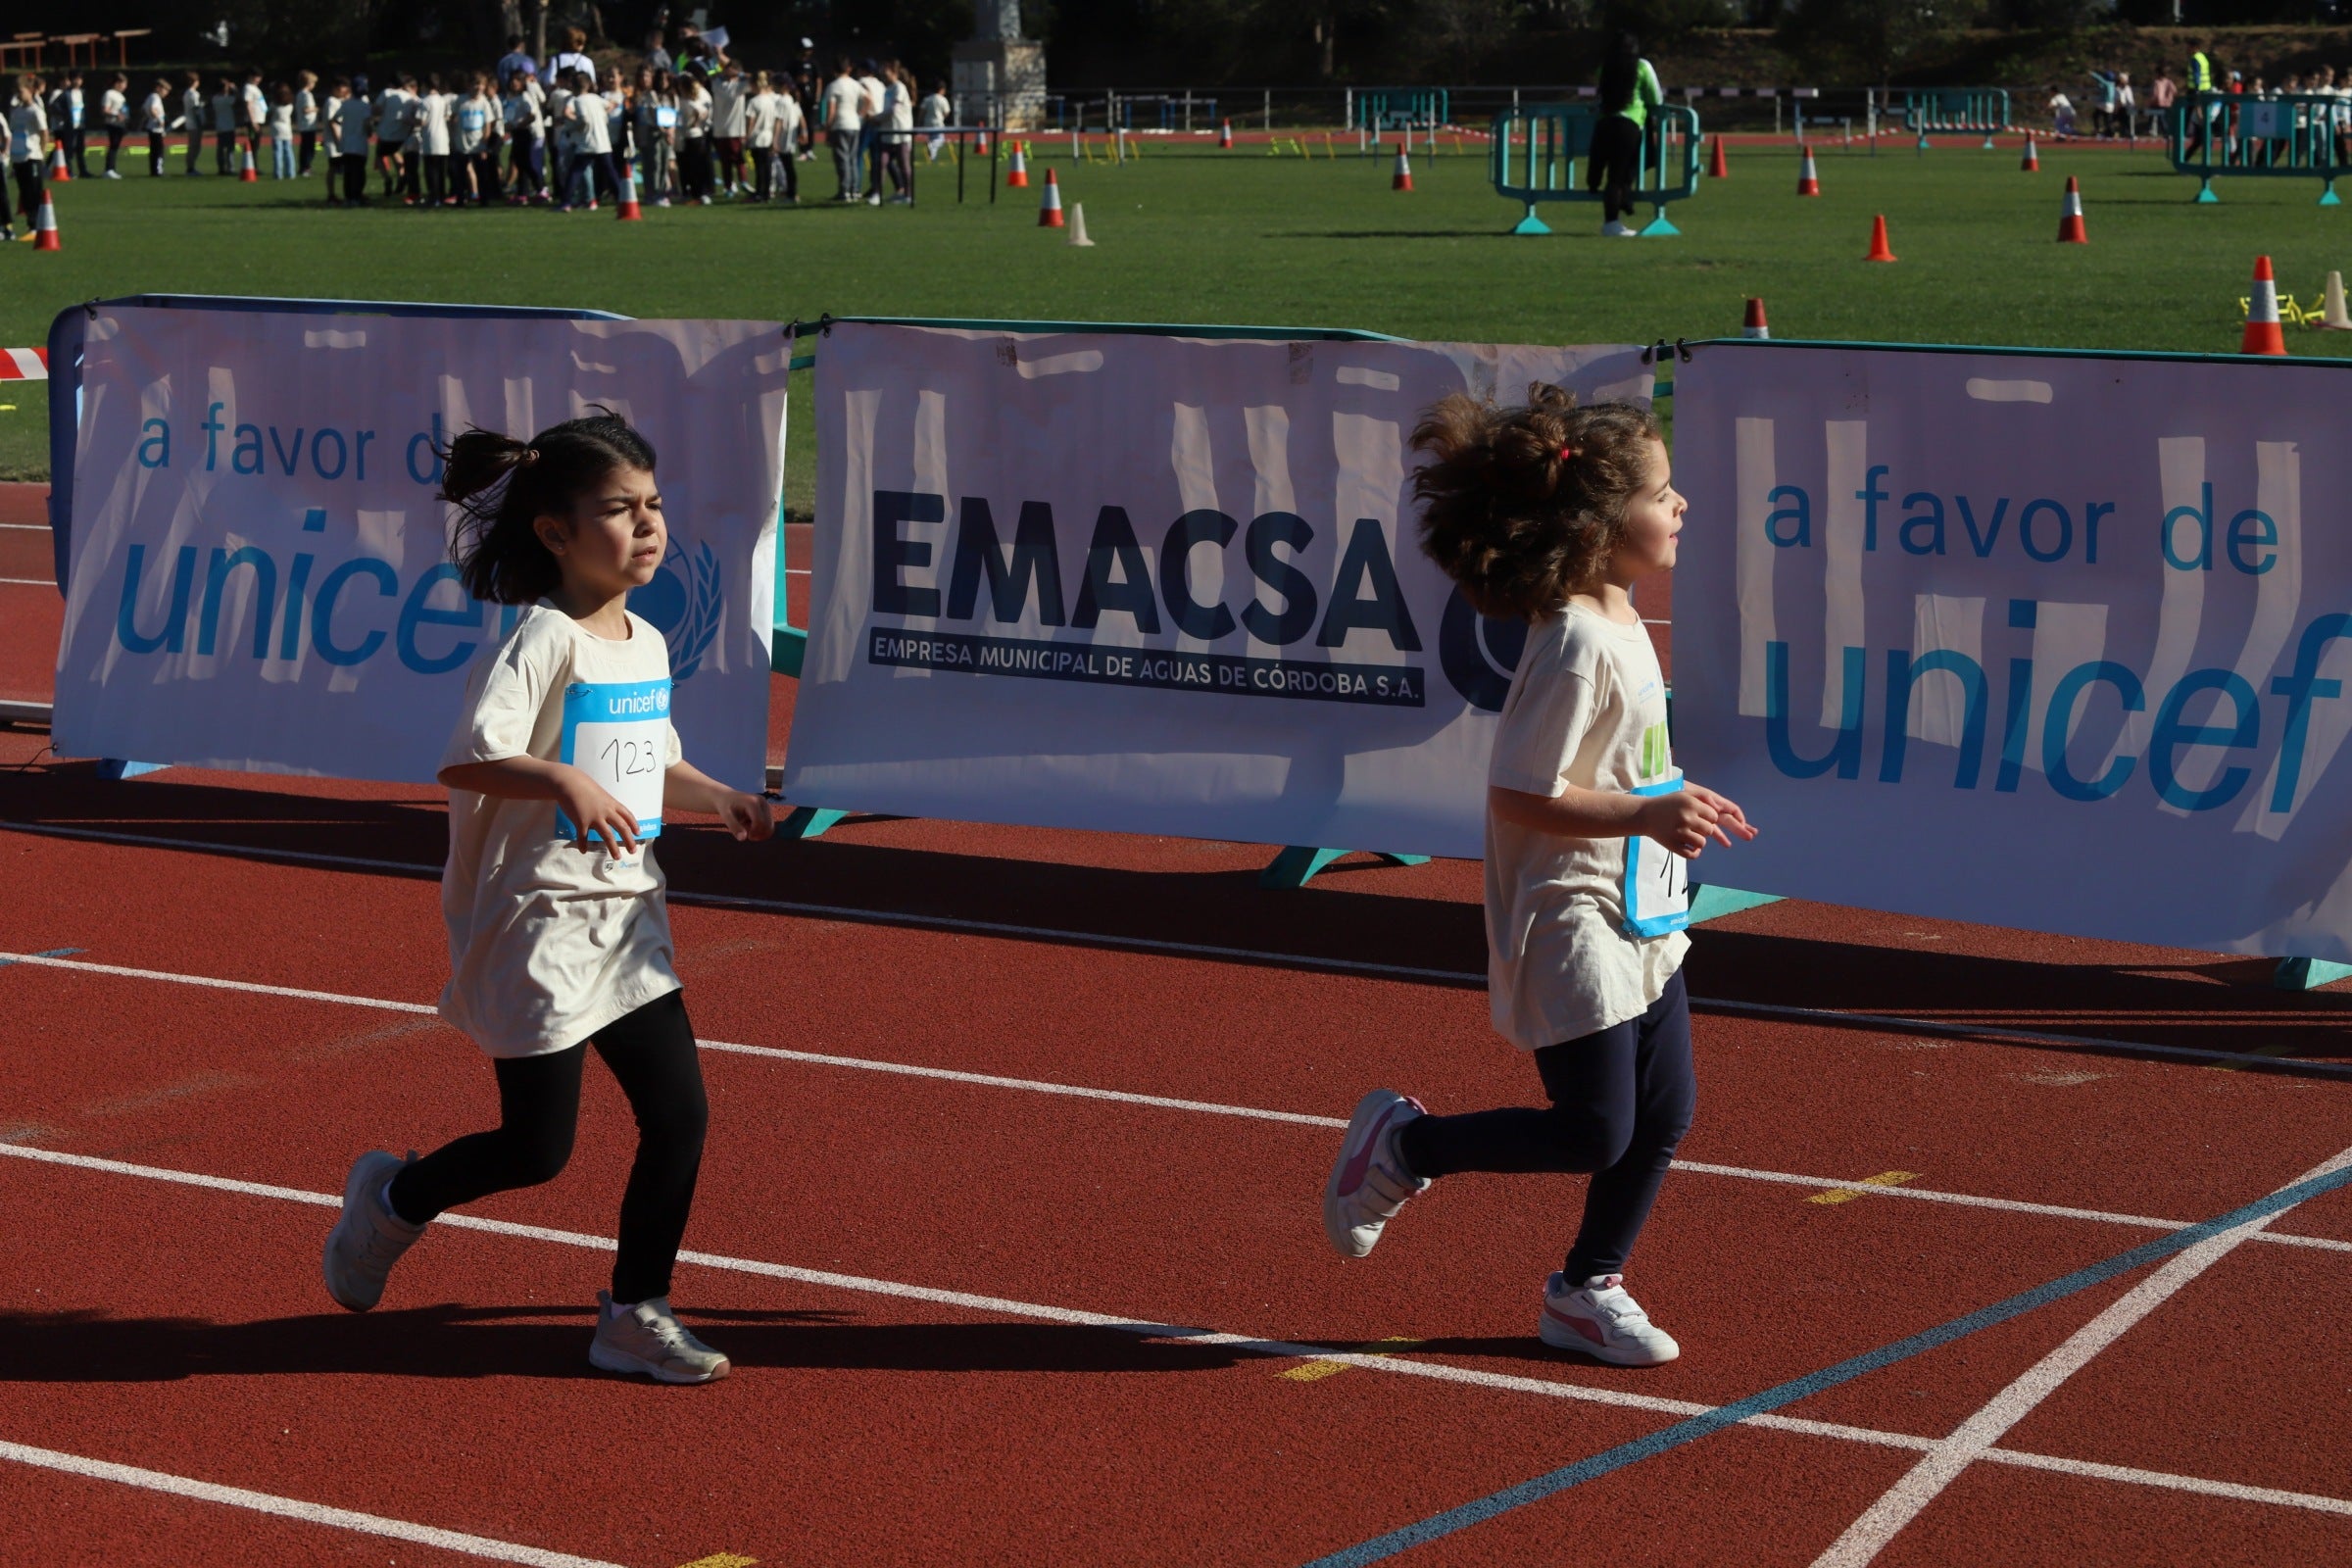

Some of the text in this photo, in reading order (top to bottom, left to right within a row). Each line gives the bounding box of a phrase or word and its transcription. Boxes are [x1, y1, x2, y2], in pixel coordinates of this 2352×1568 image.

[138, 402, 441, 486] a favor d
[1765, 466, 2278, 575] a favor de
[117, 510, 517, 674] unice
[872, 490, 1422, 653] EMACSA
[609, 689, 655, 714] unicef
[874, 637, 1419, 699] EMPRESA MUNICIPAL DE AGUAS DE CÓRDOBA S.A.
[1765, 599, 2352, 813] unicef
[601, 738, 657, 783] 123
